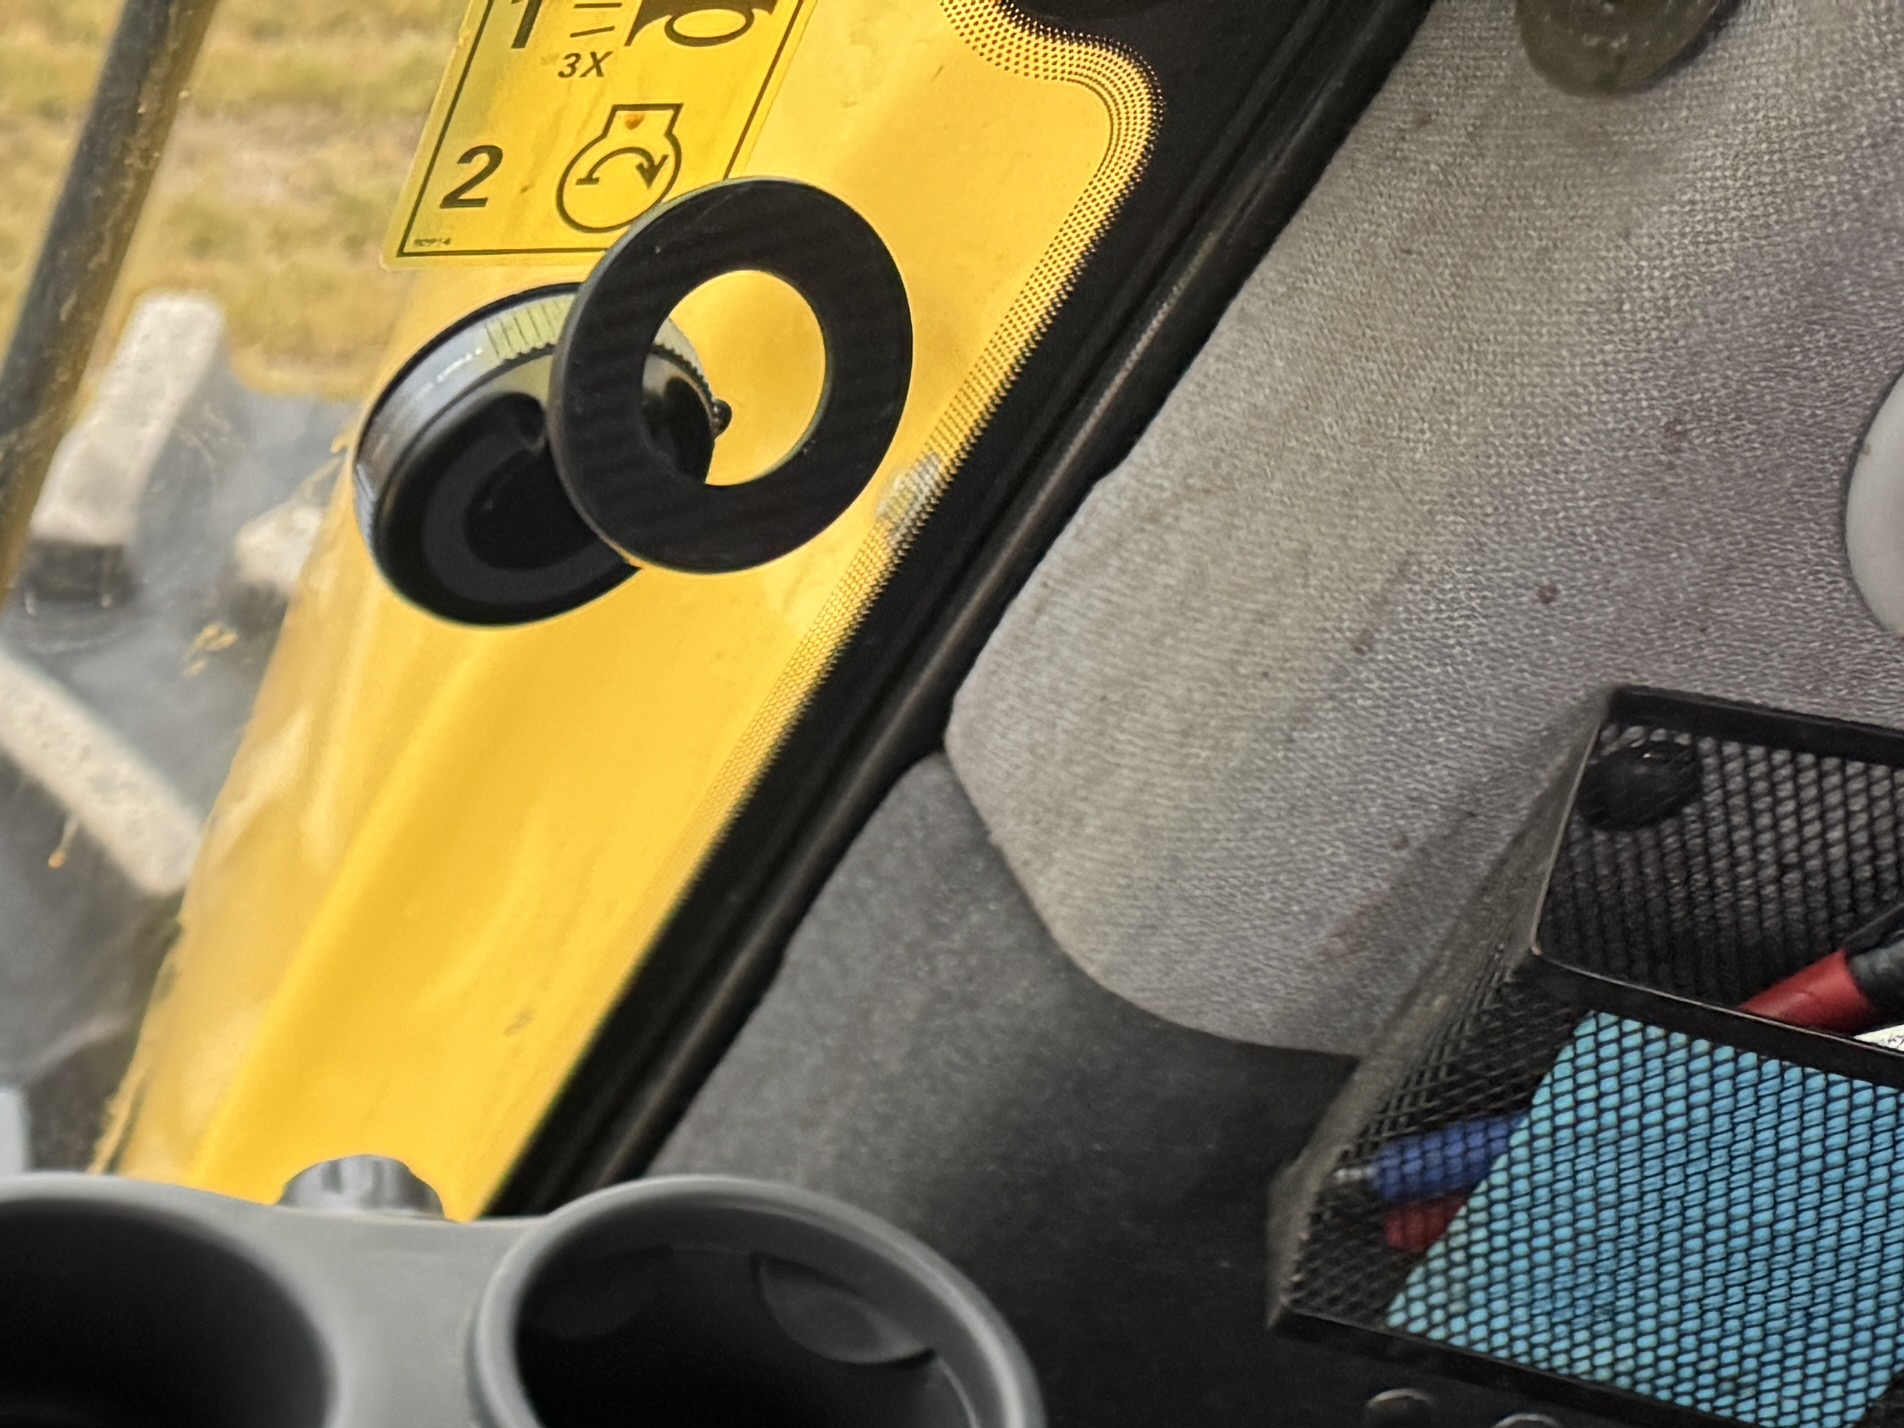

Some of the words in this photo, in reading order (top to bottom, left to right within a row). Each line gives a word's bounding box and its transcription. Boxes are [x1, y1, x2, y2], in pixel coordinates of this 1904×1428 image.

[511, 0, 543, 49] 1
[558, 50, 614, 78] 3X
[439, 144, 503, 209] 2
